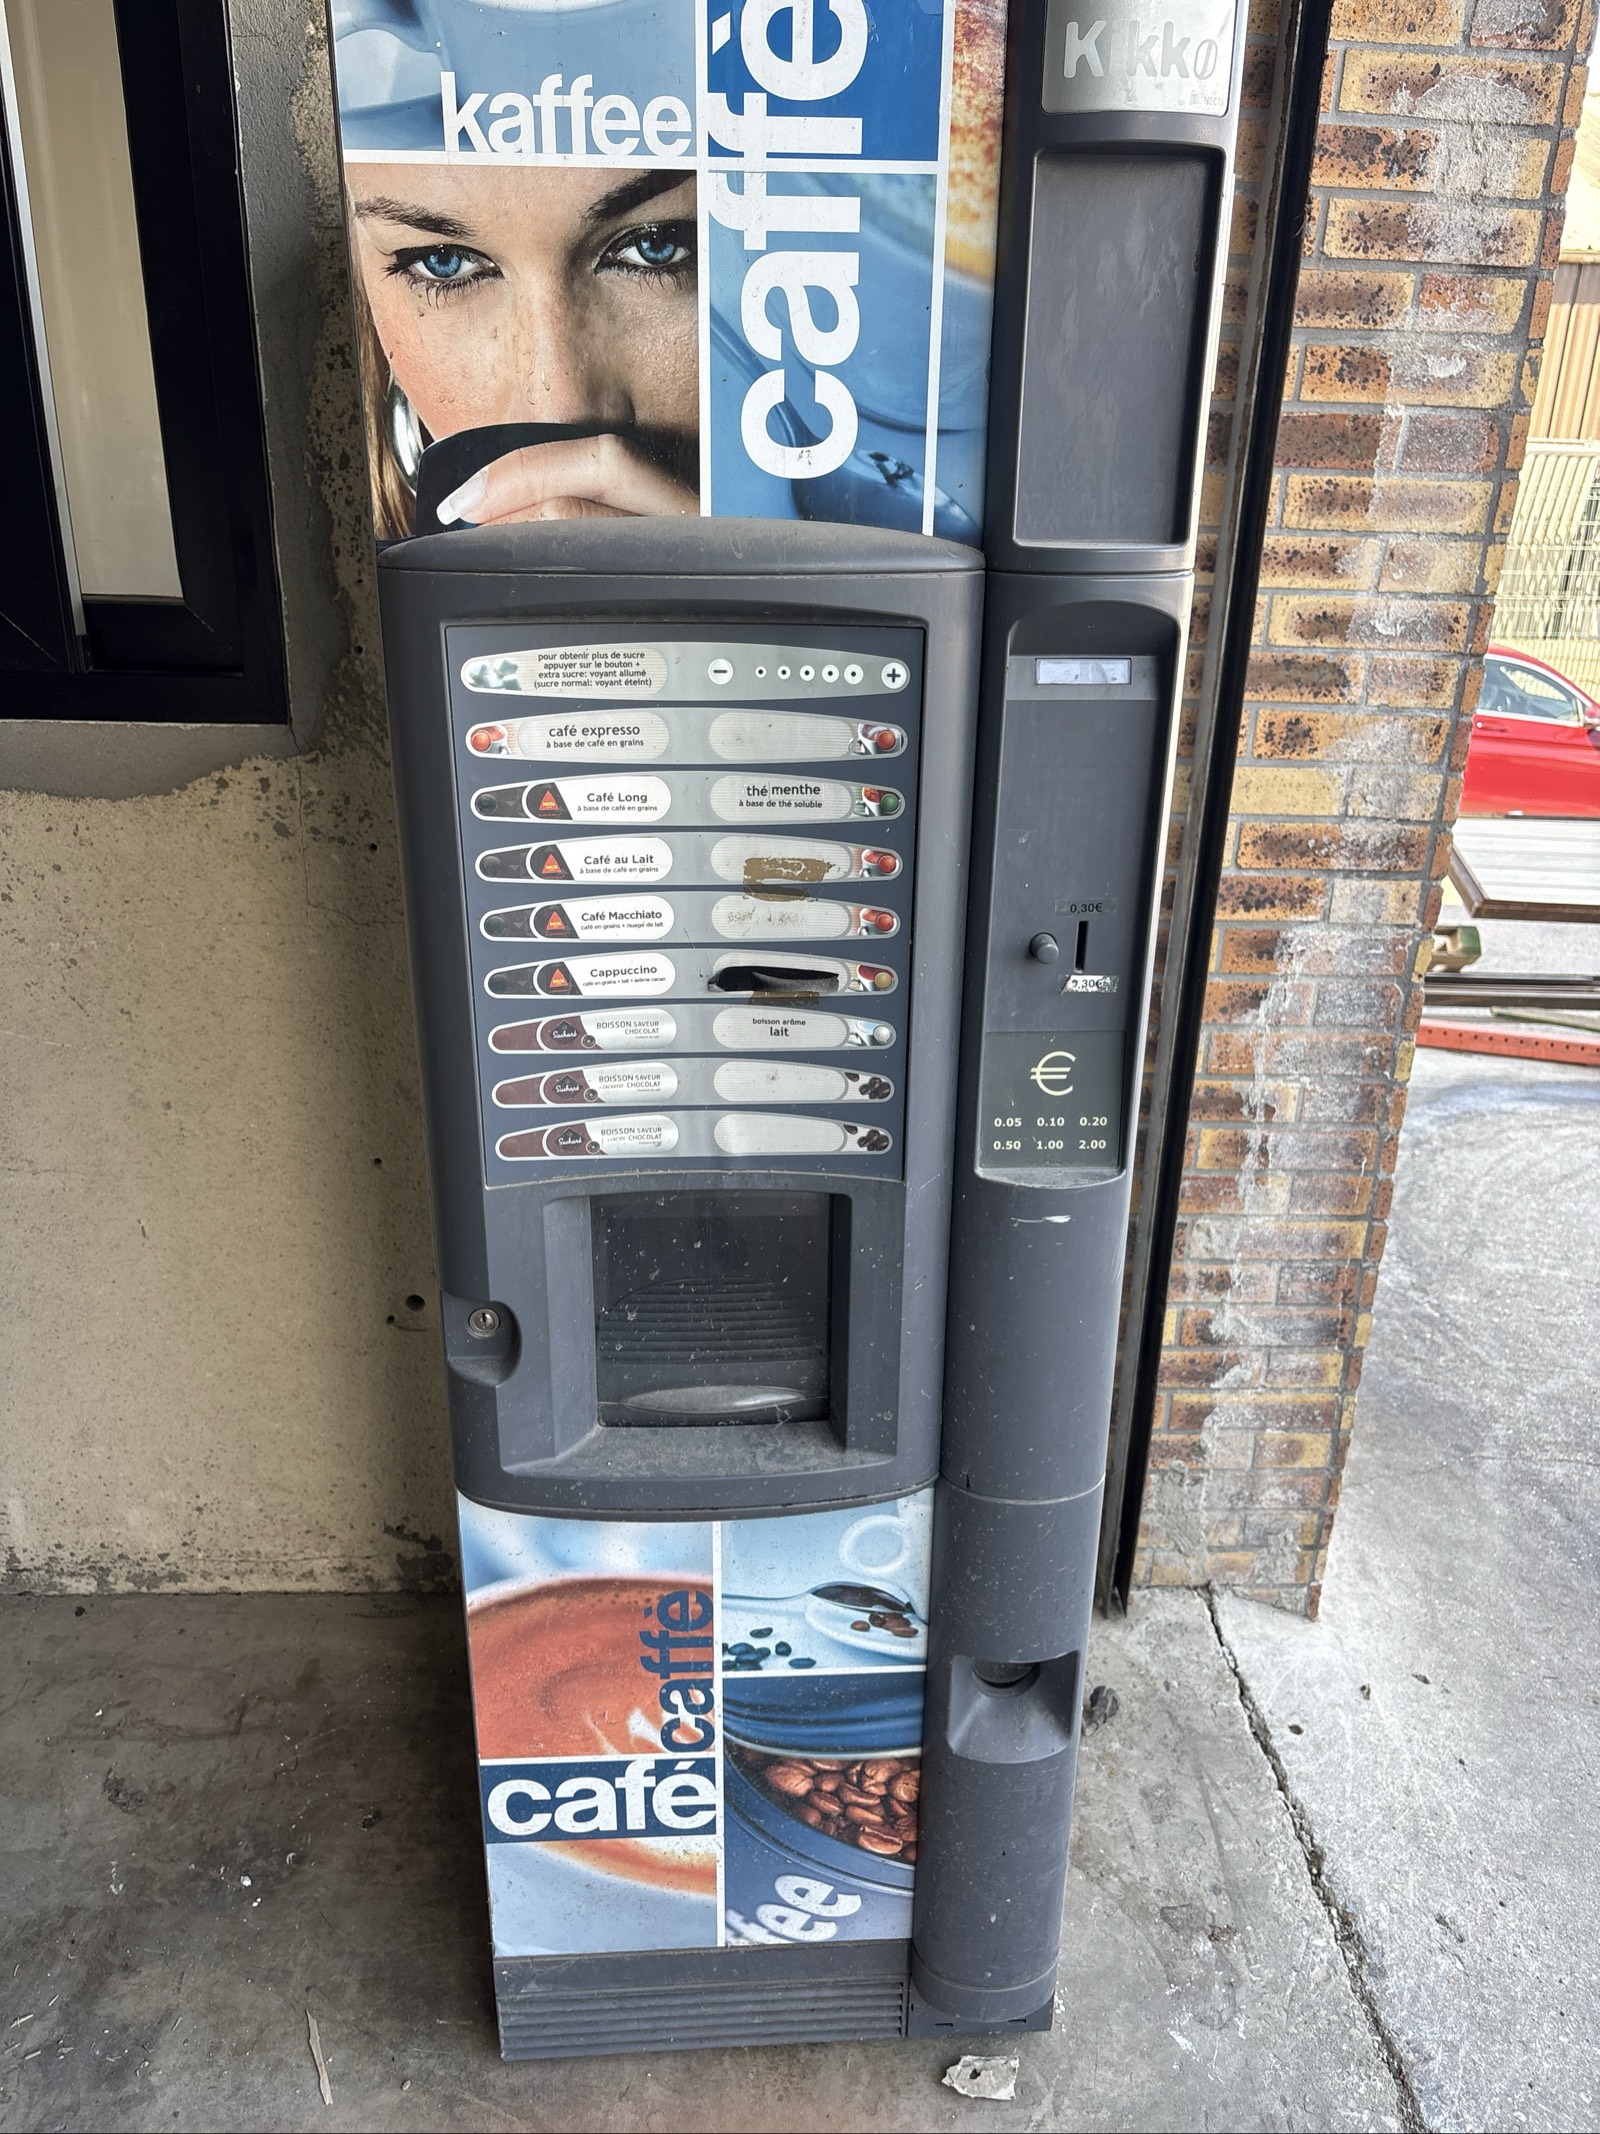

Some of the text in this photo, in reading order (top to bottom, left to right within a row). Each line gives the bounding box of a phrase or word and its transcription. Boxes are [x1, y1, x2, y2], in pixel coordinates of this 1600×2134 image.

[441, 71, 693, 156] kaffee
[707, 0, 868, 480] caffè
[538, 653, 557, 662] pour
[560, 652, 589, 660] obtenir
[592, 651, 608, 660] plus
[611, 651, 621, 659] de
[543, 662, 577, 671] appuyer
[604, 660, 633, 668] bouton
[538, 671, 560, 679] extra
[590, 670, 617, 679] voyant
[619, 669, 646, 677] allumé
[534, 678, 652, 689] (sucre normal: voyant éteint)
[549, 725, 640, 738] café expresso
[587, 739, 605, 747] café
[620, 739, 644, 748] grains
[746, 783, 821, 797] thé menthe
[587, 792, 648, 803] Café Long
[746, 799, 764, 807] base
[794, 800, 823, 808] soluble
[584, 855, 654, 865] Café au Lait
[1070, 903, 1103, 914] 0,30€
[581, 910, 662, 921] Café Macchiato
[605, 923, 620, 931] grains
[590, 965, 657, 978] Cappuccino
[596, 1020, 659, 1030] BOISSON SAVEUR
[752, 1017, 806, 1026] boisson arôme
[552, 1029, 577, 1039] Suchard
[770, 1026, 789, 1037] lait
[599, 1074, 634, 1083] BOISSON
[1030, 1051, 1076, 1096] €
[555, 1084, 579, 1093] Suchard
[994, 1117, 1108, 1127] 0.05 0.10 0.20
[601, 1127, 635, 1136] BOISSON
[558, 1137, 582, 1146] Suchard
[993, 1140, 1106, 1150] 0.50 1.00 2.00
[639, 1590, 715, 1753] caffè
[487, 1758, 717, 1836] café
